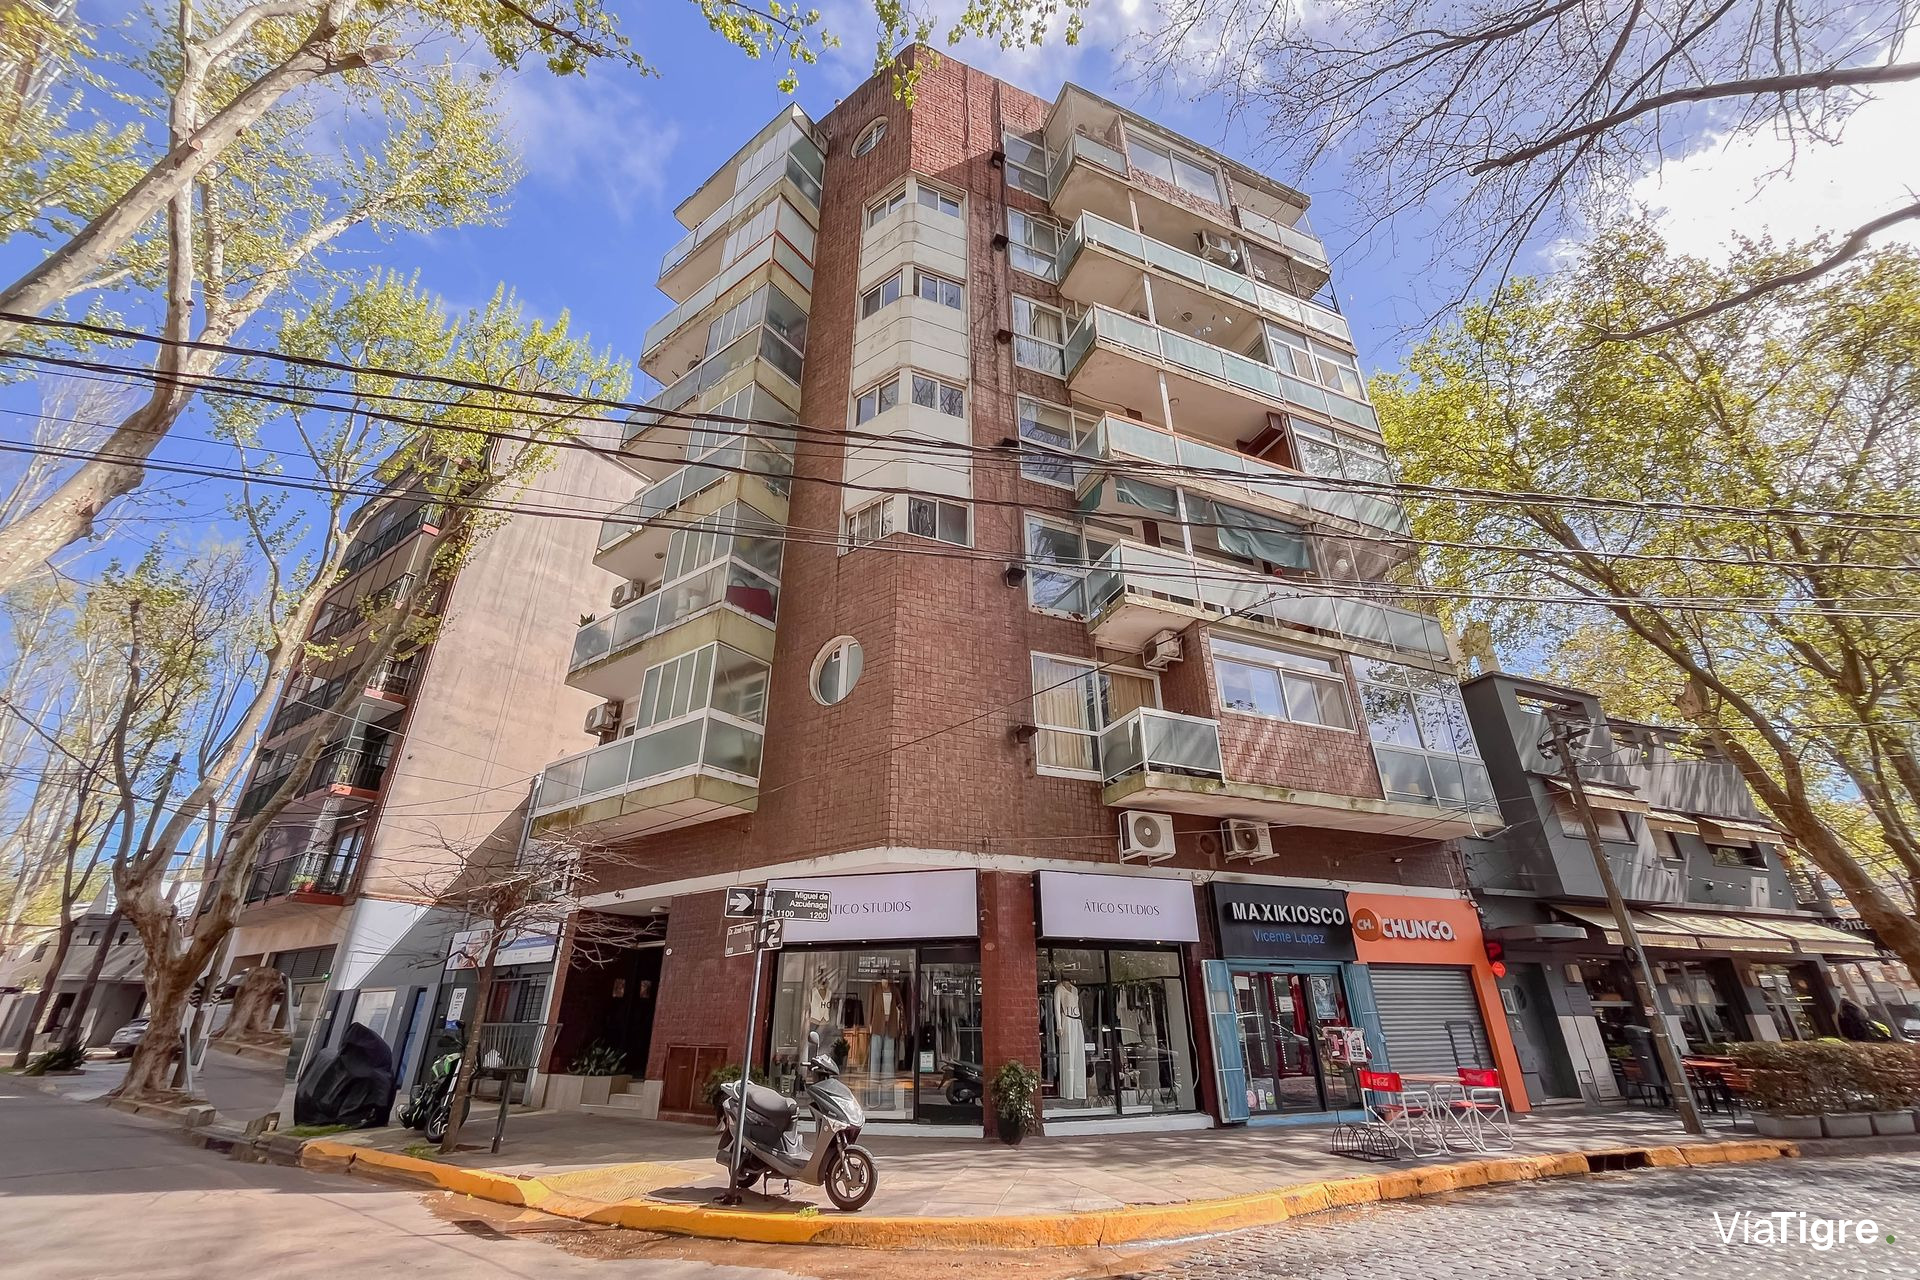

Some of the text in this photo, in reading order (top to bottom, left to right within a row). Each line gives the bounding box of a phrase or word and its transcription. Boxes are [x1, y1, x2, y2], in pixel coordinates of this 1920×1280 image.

[795, 891, 818, 900] Miguel
[790, 900, 828, 909] Azcuénaga
[831, 901, 912, 915] TICO STUDIOS
[1083, 899, 1160, 916] ÁTICO STUDIOS
[810, 911, 827, 919] 1200
[1231, 902, 1345, 926] MAXIKIOSCO
[1252, 929, 1325, 945] Vicente Lopez
